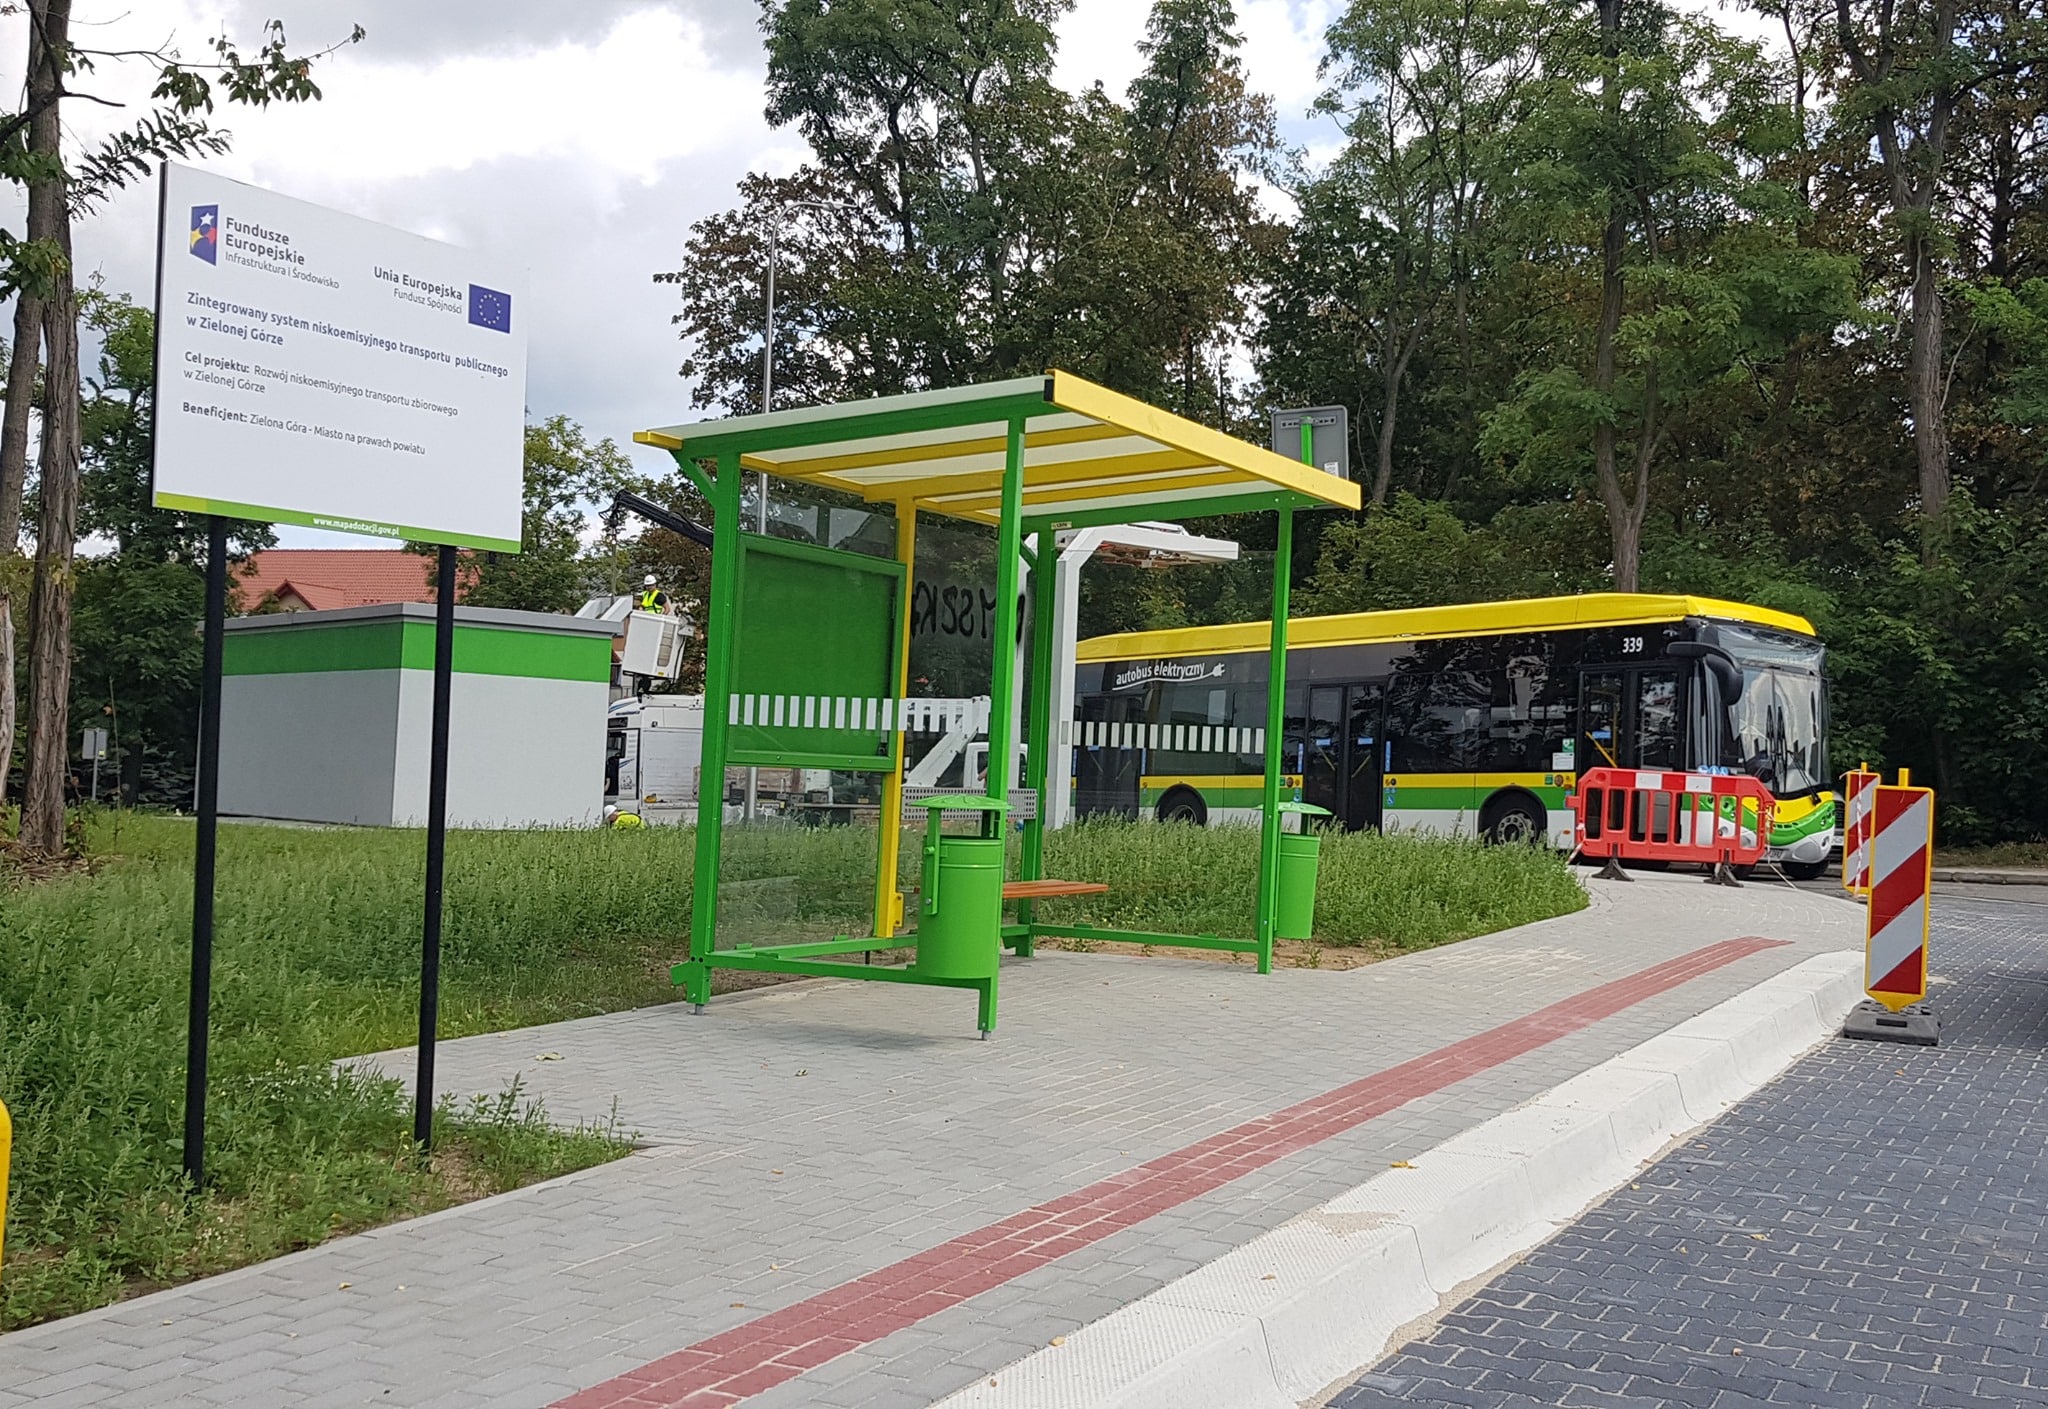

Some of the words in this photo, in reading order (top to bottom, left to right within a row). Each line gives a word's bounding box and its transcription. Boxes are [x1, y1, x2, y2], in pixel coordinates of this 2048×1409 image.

[225, 217, 290, 245] Fundusze
[225, 234, 305, 265] Europejskie
[225, 252, 286, 275] Infrastruktura
[292, 267, 340, 289] Środowisko
[374, 266, 399, 283] Unia
[402, 274, 463, 300] Europejska
[393, 288, 426, 305] Fundusz
[427, 297, 462, 314] Spójności
[186, 315, 197, 326] w
[200, 316, 248, 339] Zielonej
[250, 328, 284, 345] Górze
[187, 291, 268, 322] Zintegrowany
[270, 312, 310, 330] system
[312, 321, 397, 351] niskoemisyjnego
[399, 342, 451, 363] transportu
[455, 356, 508, 377] publicznego
[183, 369, 193, 379] w
[195, 369, 235, 389] Zielonej
[237, 378, 266, 393] Górze
[185, 351, 201, 363] Cel
[204, 356, 250, 373] projektu:
[254, 365, 288, 383] Rozwój
[290, 373, 363, 397] niskoemisyjnego
[365, 388, 410, 406] transportu
[411, 397, 458, 416] zbiorowego
[182, 401, 248, 422] Beneficjent:
[249, 413, 284, 429] Zielona
[286, 420, 307, 433] Góra
[314, 426, 343, 441] Miasto
[344, 433, 355, 442] na
[357, 434, 391, 449] prawach
[393, 442, 426, 455] powiatu
[313, 517, 400, 536] www.mapadotacji.gov.pl
[1622, 637, 1643, 653] 339
[1116, 665, 1152, 685] autobus
[1153, 661, 1205, 679] elektryczny
